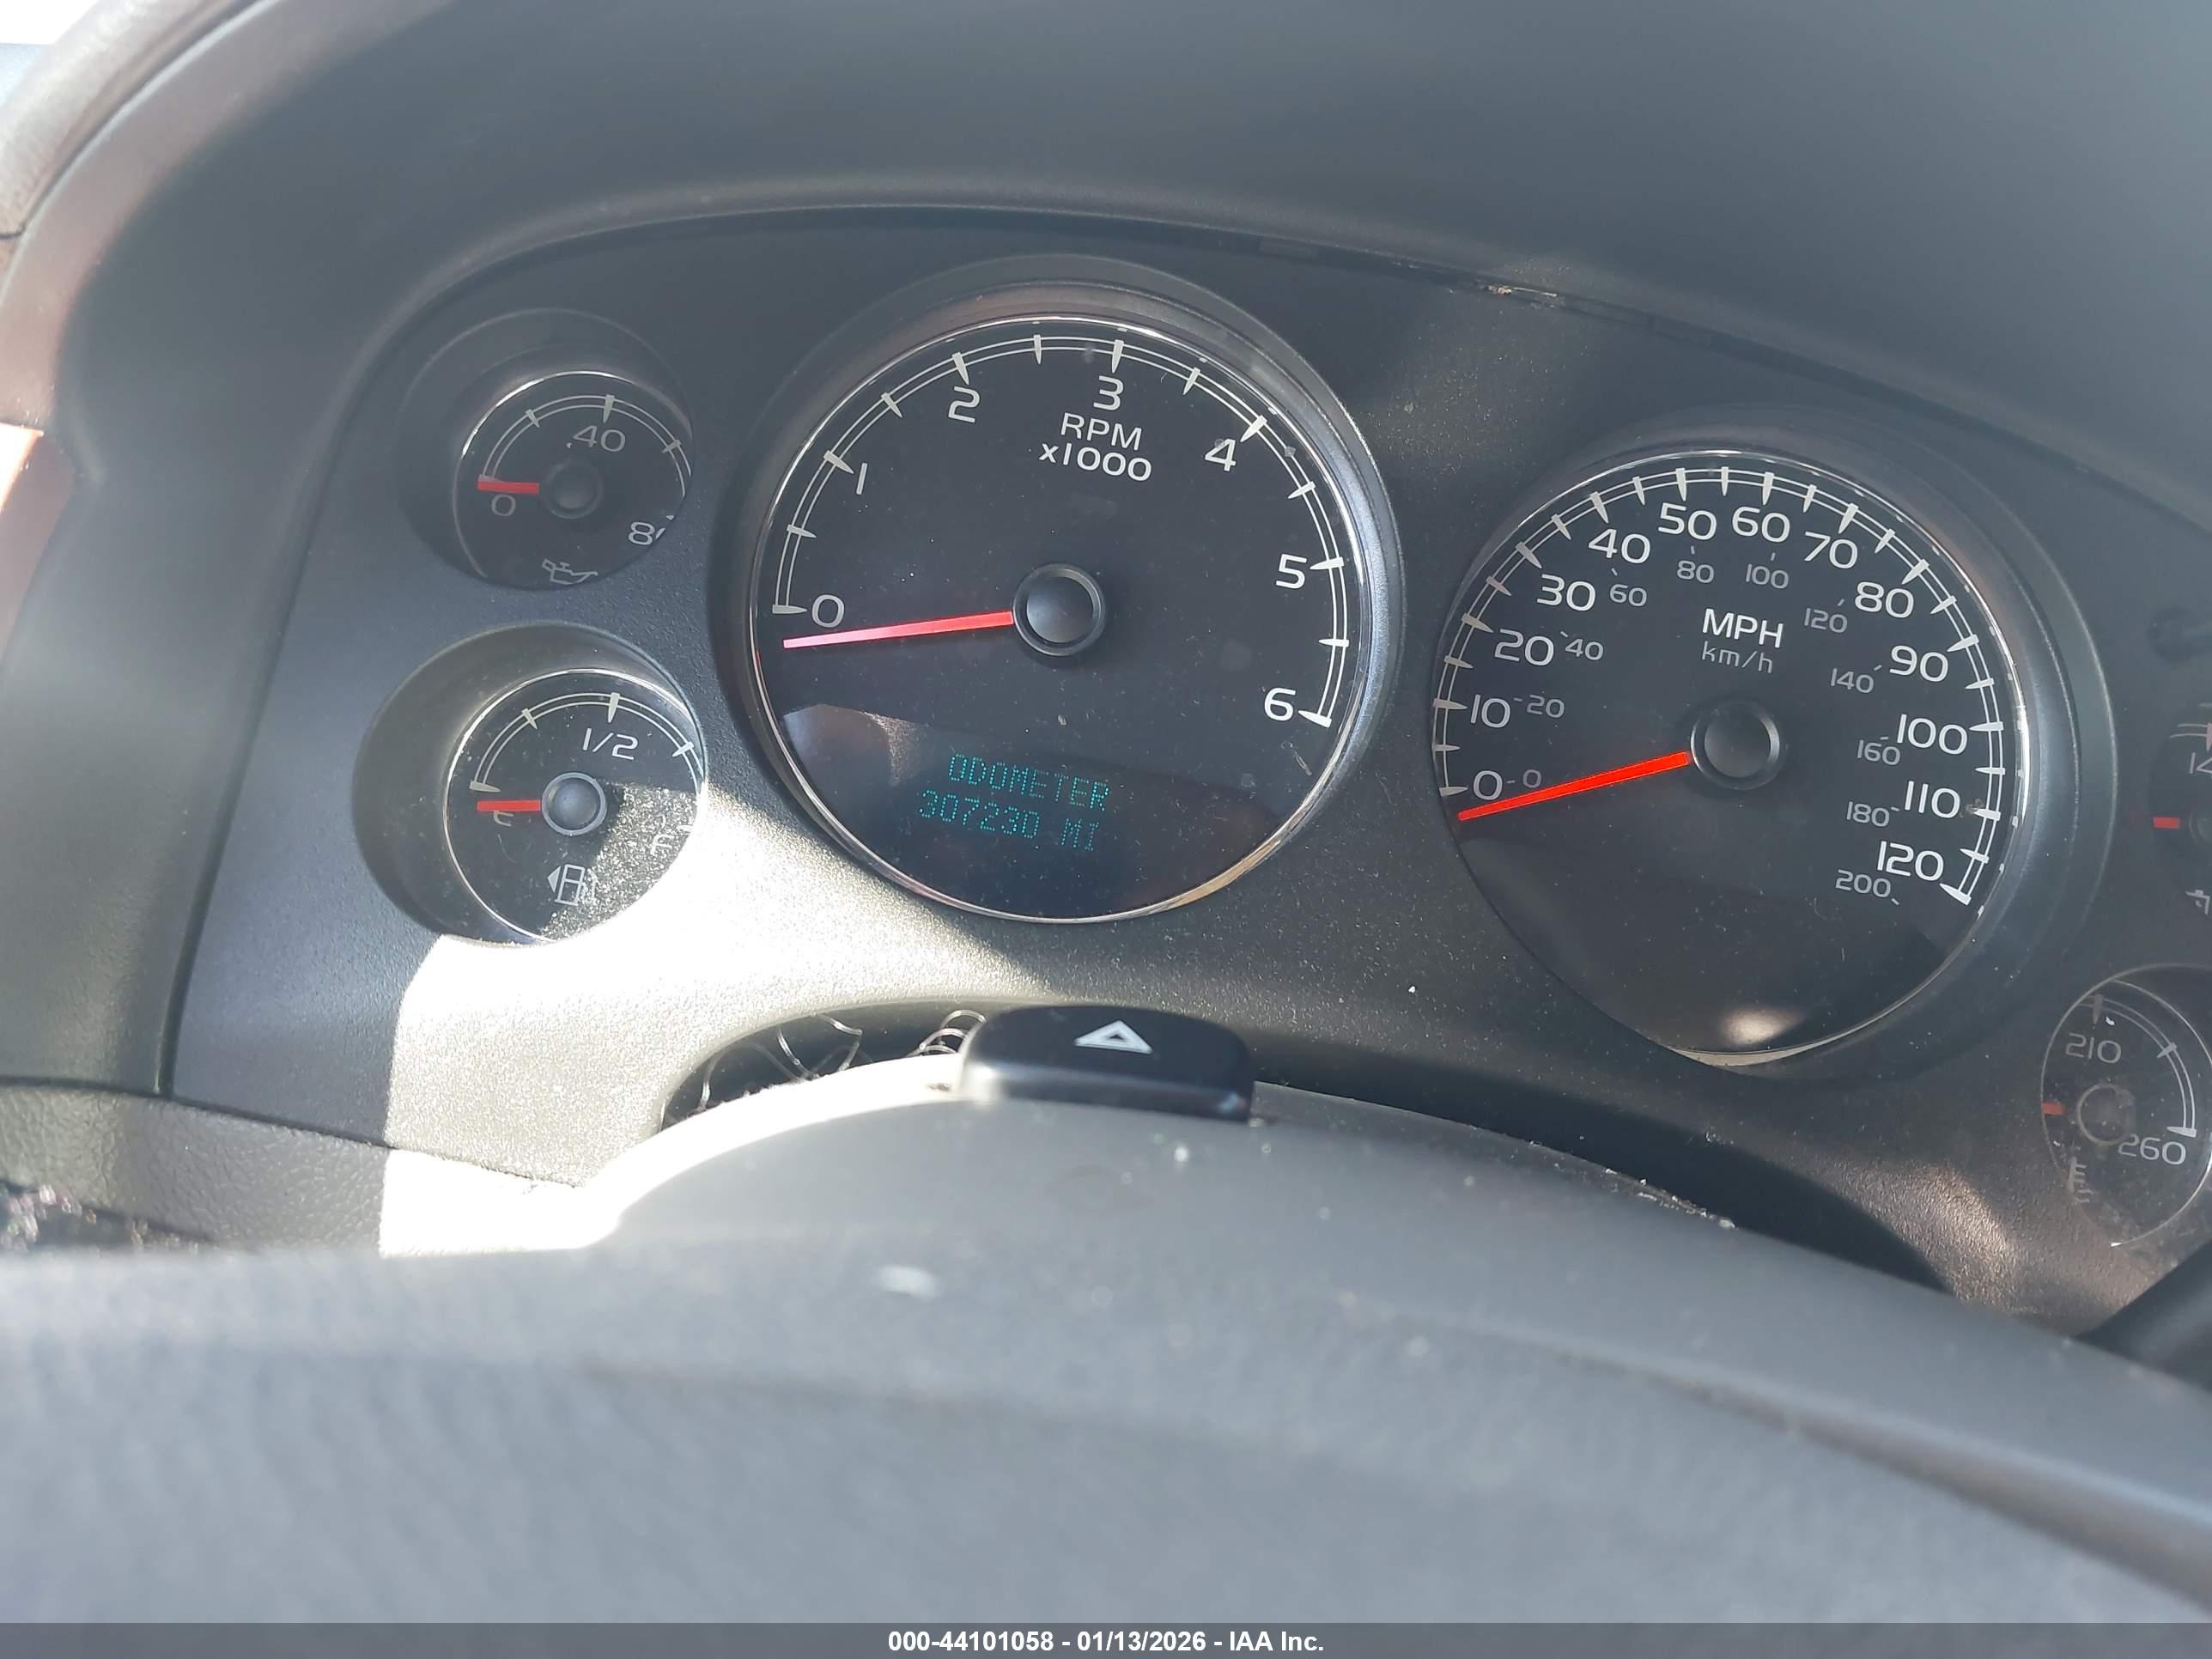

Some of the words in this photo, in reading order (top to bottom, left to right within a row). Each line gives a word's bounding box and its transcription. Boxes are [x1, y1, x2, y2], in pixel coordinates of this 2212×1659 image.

[948, 386, 981, 423] 2
[1092, 375, 1125, 411] 3
[573, 425, 626, 453] 40
[1060, 412, 1143, 451] RPM
[1038, 442, 1152, 482] x1000
[1204, 439, 1237, 472] 4
[856, 463, 868, 495] 1
[491, 494, 516, 516] 0
[1657, 502, 1717, 541] 50
[1732, 507, 1790, 543] 60
[1588, 528, 1650, 564] 40
[1804, 531, 1858, 569] 70
[1275, 553, 1308, 589] 5
[1676, 560, 1715, 584] 80
[1746, 563, 1790, 590] 100
[1537, 574, 1596, 611] 30
[1609, 584, 1647, 607] 60
[1854, 581, 1914, 618] 80
[811, 594, 845, 628] 0
[1803, 607, 1848, 634] 120
[1702, 608, 1784, 648] MPH
[1494, 629, 1554, 666] 20
[1565, 638, 1604, 660] 40
[1701, 641, 1773, 674] km/h
[1889, 645, 1948, 683] 90
[1830, 668, 1875, 694] 140
[1263, 687, 1297, 721] 6
[1470, 695, 1511, 728] 10
[1526, 695, 1565, 719] 20
[583, 727, 639, 760] 1/2
[1896, 714, 1968, 755] 100
[1856, 739, 1901, 766] 160
[948, 753, 1110, 811] ODOMETER
[1473, 770, 1503, 800] 0
[1522, 769, 1542, 788] 0
[1846, 801, 1890, 827] 180
[1905, 781, 1960, 818] 110
[920, 789, 1041, 839] 307230
[1060, 817, 1099, 851] MI
[1876, 841, 1944, 881] 120
[1835, 869, 1891, 898] 200
[2065, 1032, 2122, 1064] 210
[2117, 1133, 2186, 1166] 260
